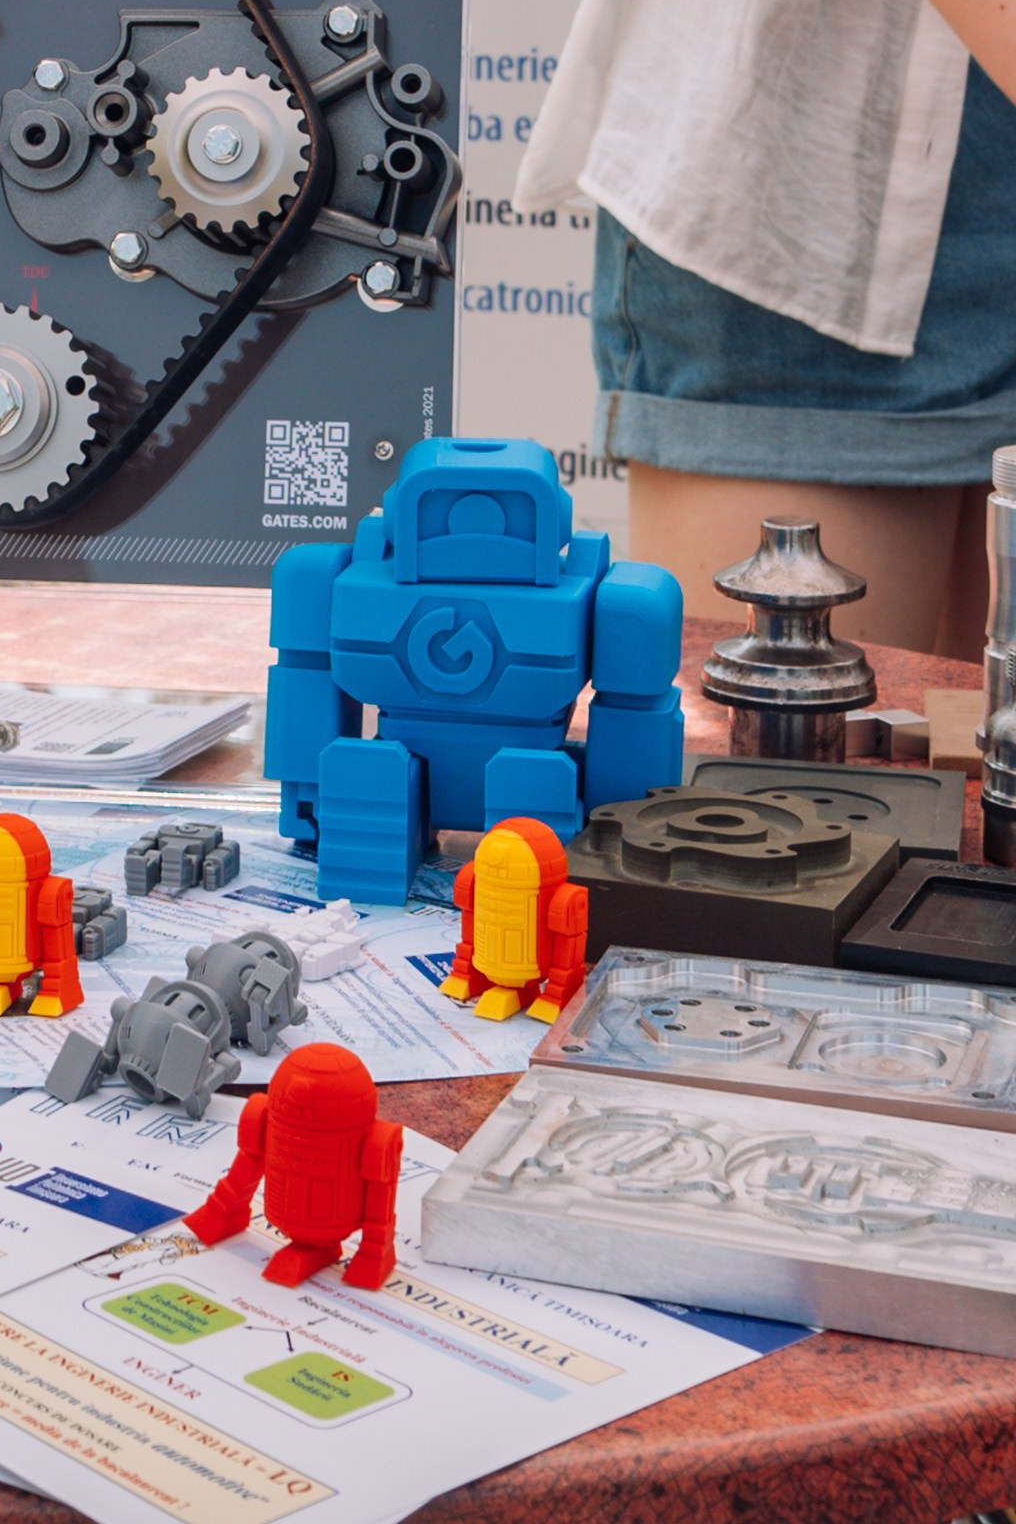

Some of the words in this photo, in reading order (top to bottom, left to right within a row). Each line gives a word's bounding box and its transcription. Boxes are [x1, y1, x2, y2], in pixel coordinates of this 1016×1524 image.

[470, 47, 558, 82] nerie
[422, 385, 434, 416] 2021
[261, 513, 348, 530] GATES.COM
[384, 1279, 579, 1368] INDUSTRIALĂ
